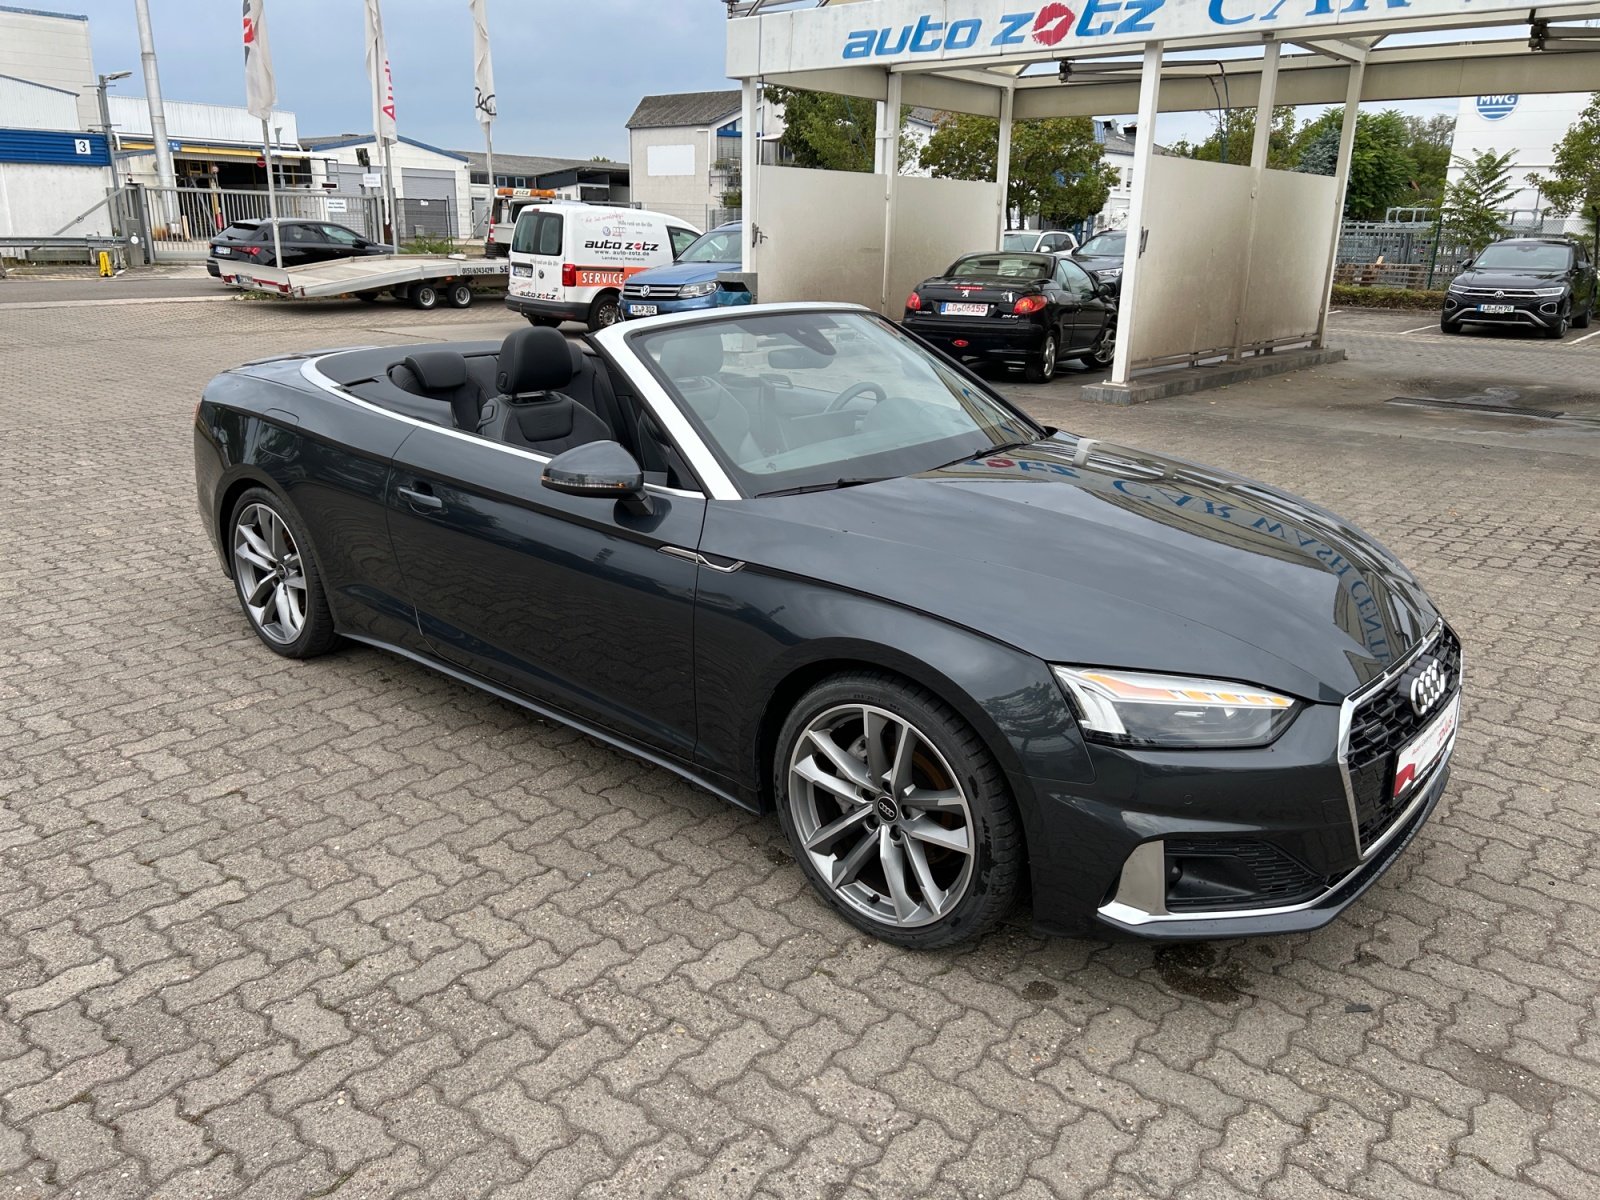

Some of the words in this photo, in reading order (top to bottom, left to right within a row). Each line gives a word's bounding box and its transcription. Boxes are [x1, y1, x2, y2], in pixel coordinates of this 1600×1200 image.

[842, 15, 983, 59] auto
[1480, 94, 1516, 105] MWG
[79, 140, 87, 152] 3
[584, 239, 622, 249] auto
[582, 272, 624, 284] SERVICE
[520, 290, 535, 298] auto
